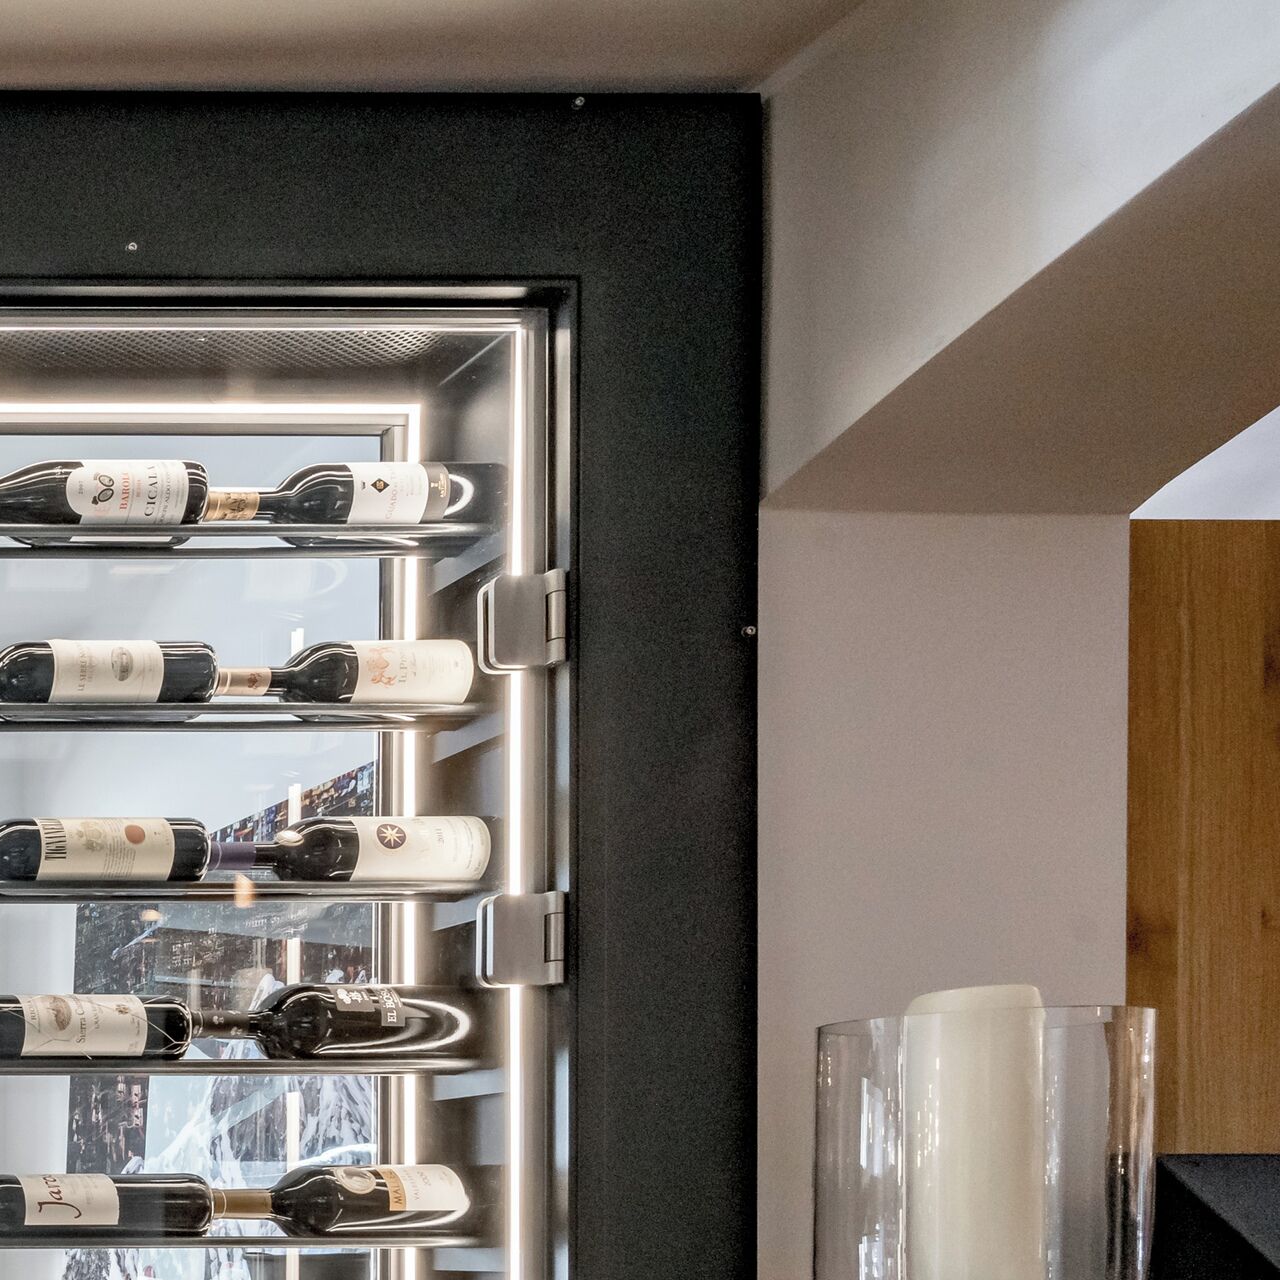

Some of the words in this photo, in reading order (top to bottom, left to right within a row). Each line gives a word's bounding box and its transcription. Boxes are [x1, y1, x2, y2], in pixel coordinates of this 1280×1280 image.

[142, 465, 159, 517] CICALA
[39, 818, 67, 862] TIGNANEL
[27, 999, 38, 1021] RIOJA
[386, 1009, 397, 1022] EL
[75, 1017, 88, 1044] Sierra
